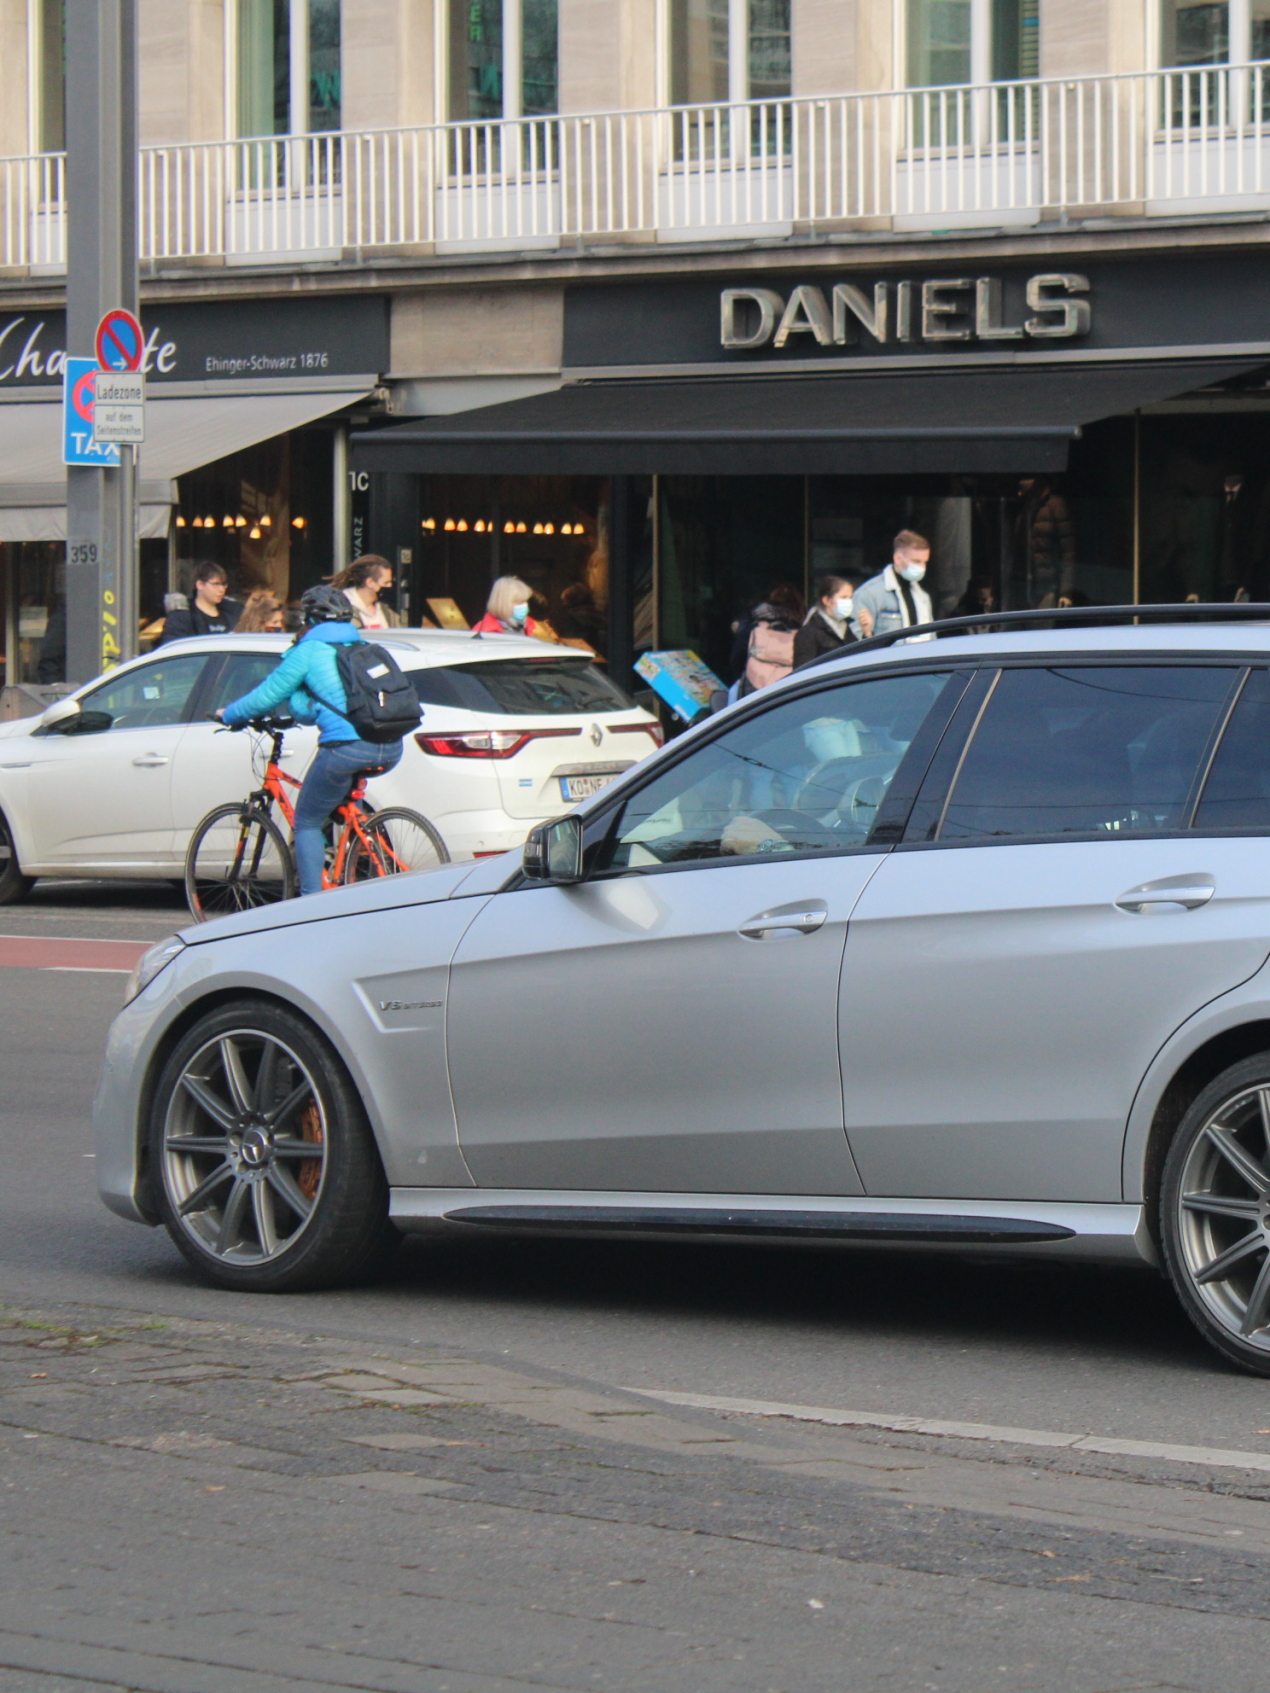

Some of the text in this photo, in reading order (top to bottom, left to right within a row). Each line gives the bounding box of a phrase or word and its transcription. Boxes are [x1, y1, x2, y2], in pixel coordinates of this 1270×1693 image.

[720, 273, 1092, 349] DANIELS
[205, 352, 329, 374] Ehinger-Schwarz 1876
[97, 386, 142, 400] Ladezone
[105, 412, 133, 422] auf dem
[348, 471, 369, 491] 1C
[71, 544, 98, 563] 359
